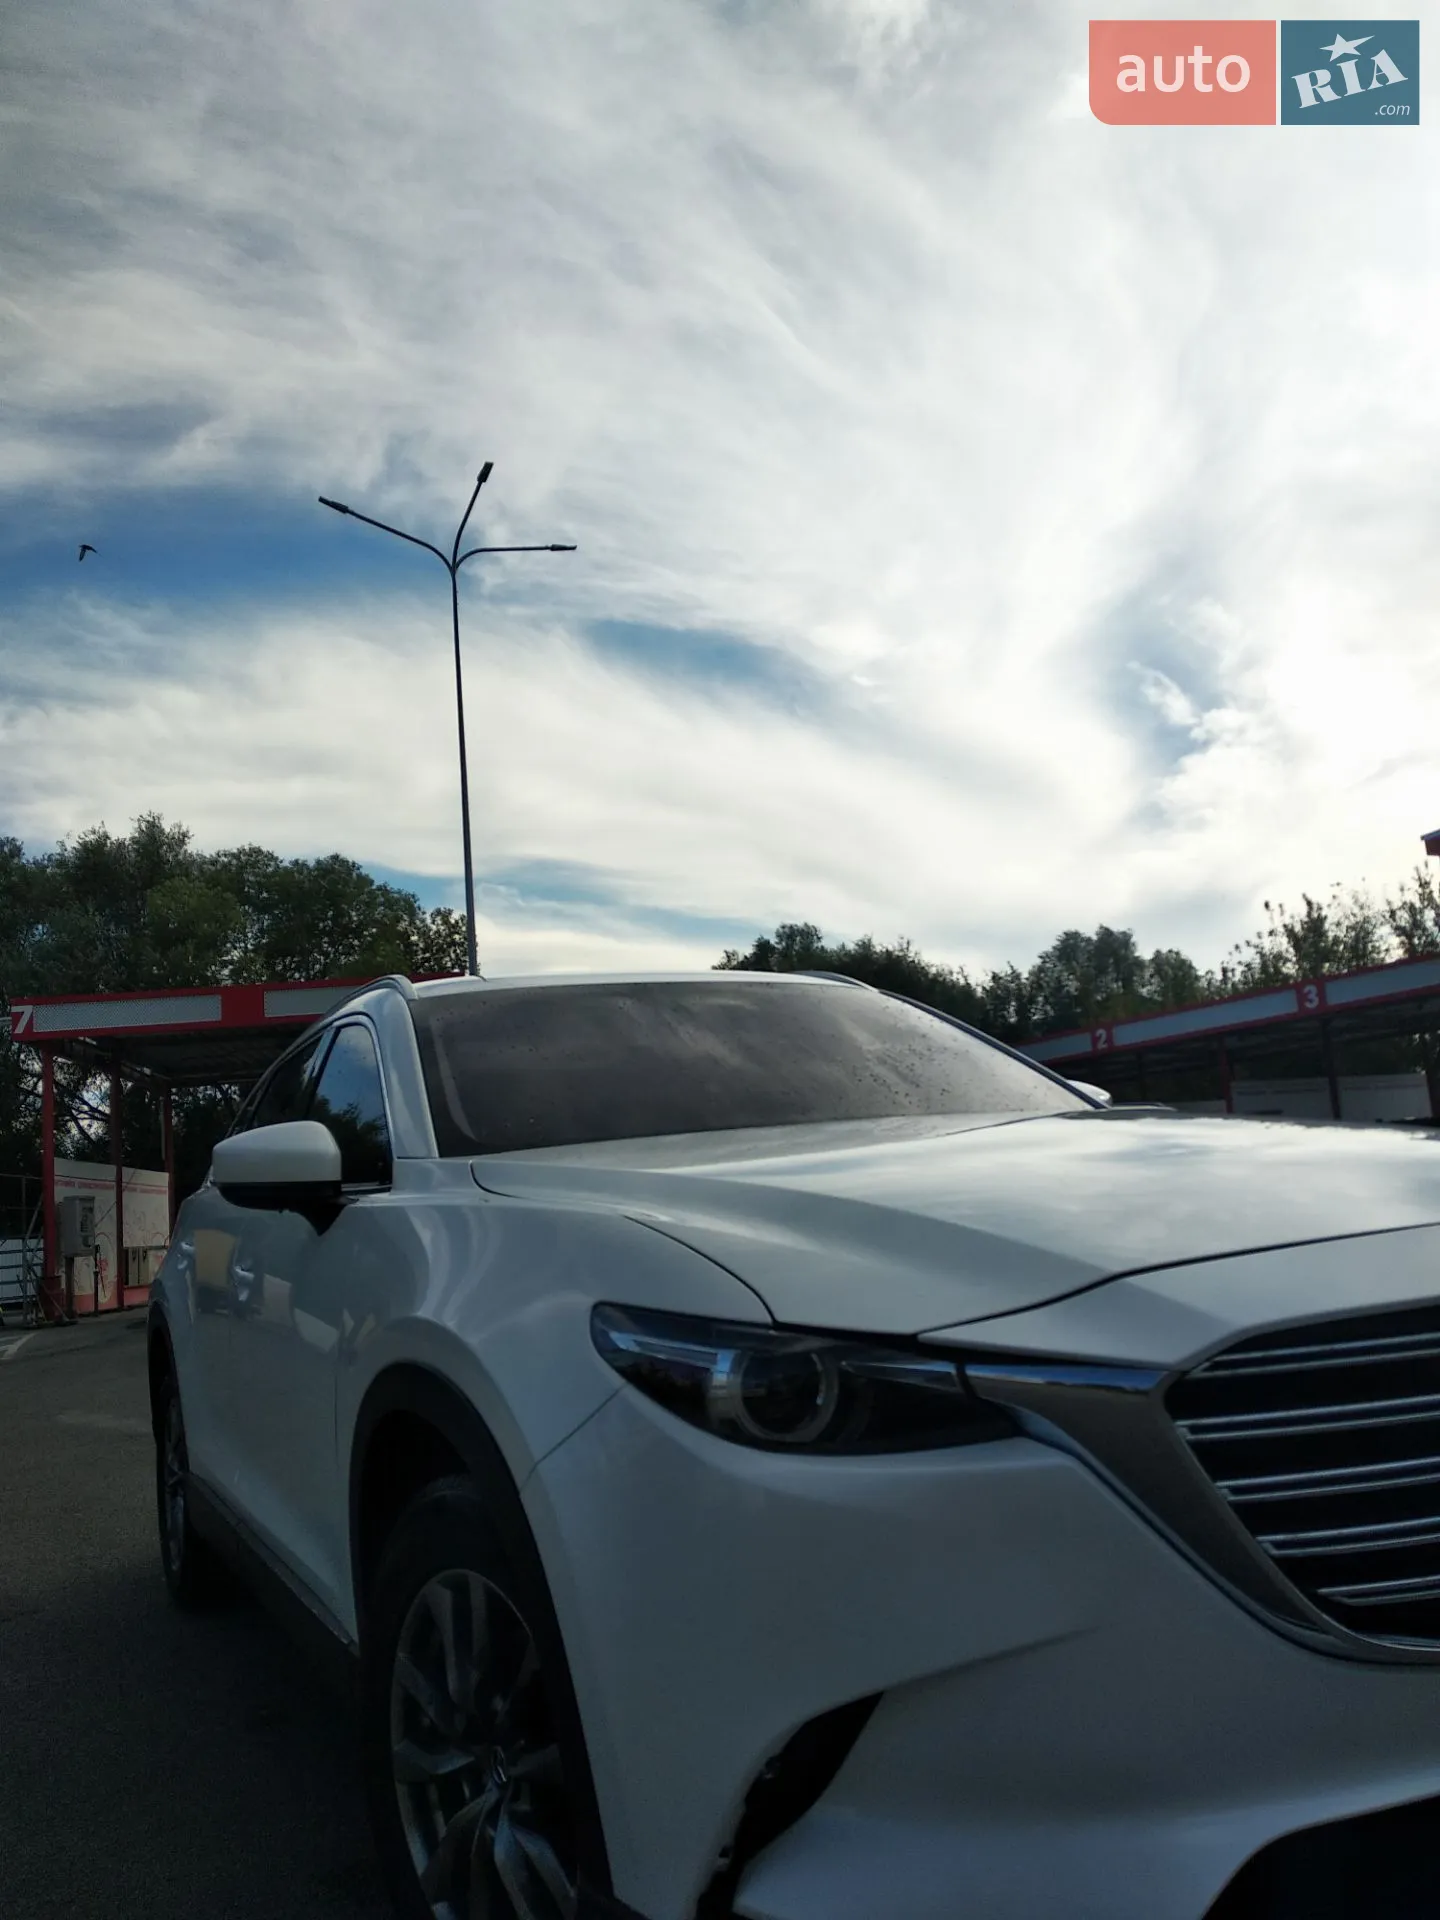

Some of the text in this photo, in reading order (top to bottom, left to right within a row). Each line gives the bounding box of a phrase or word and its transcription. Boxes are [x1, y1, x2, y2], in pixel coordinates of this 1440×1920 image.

[1303, 984, 1319, 1008] 3
[11, 1005, 33, 1033] 7
[1096, 1029, 1108, 1049] 2
